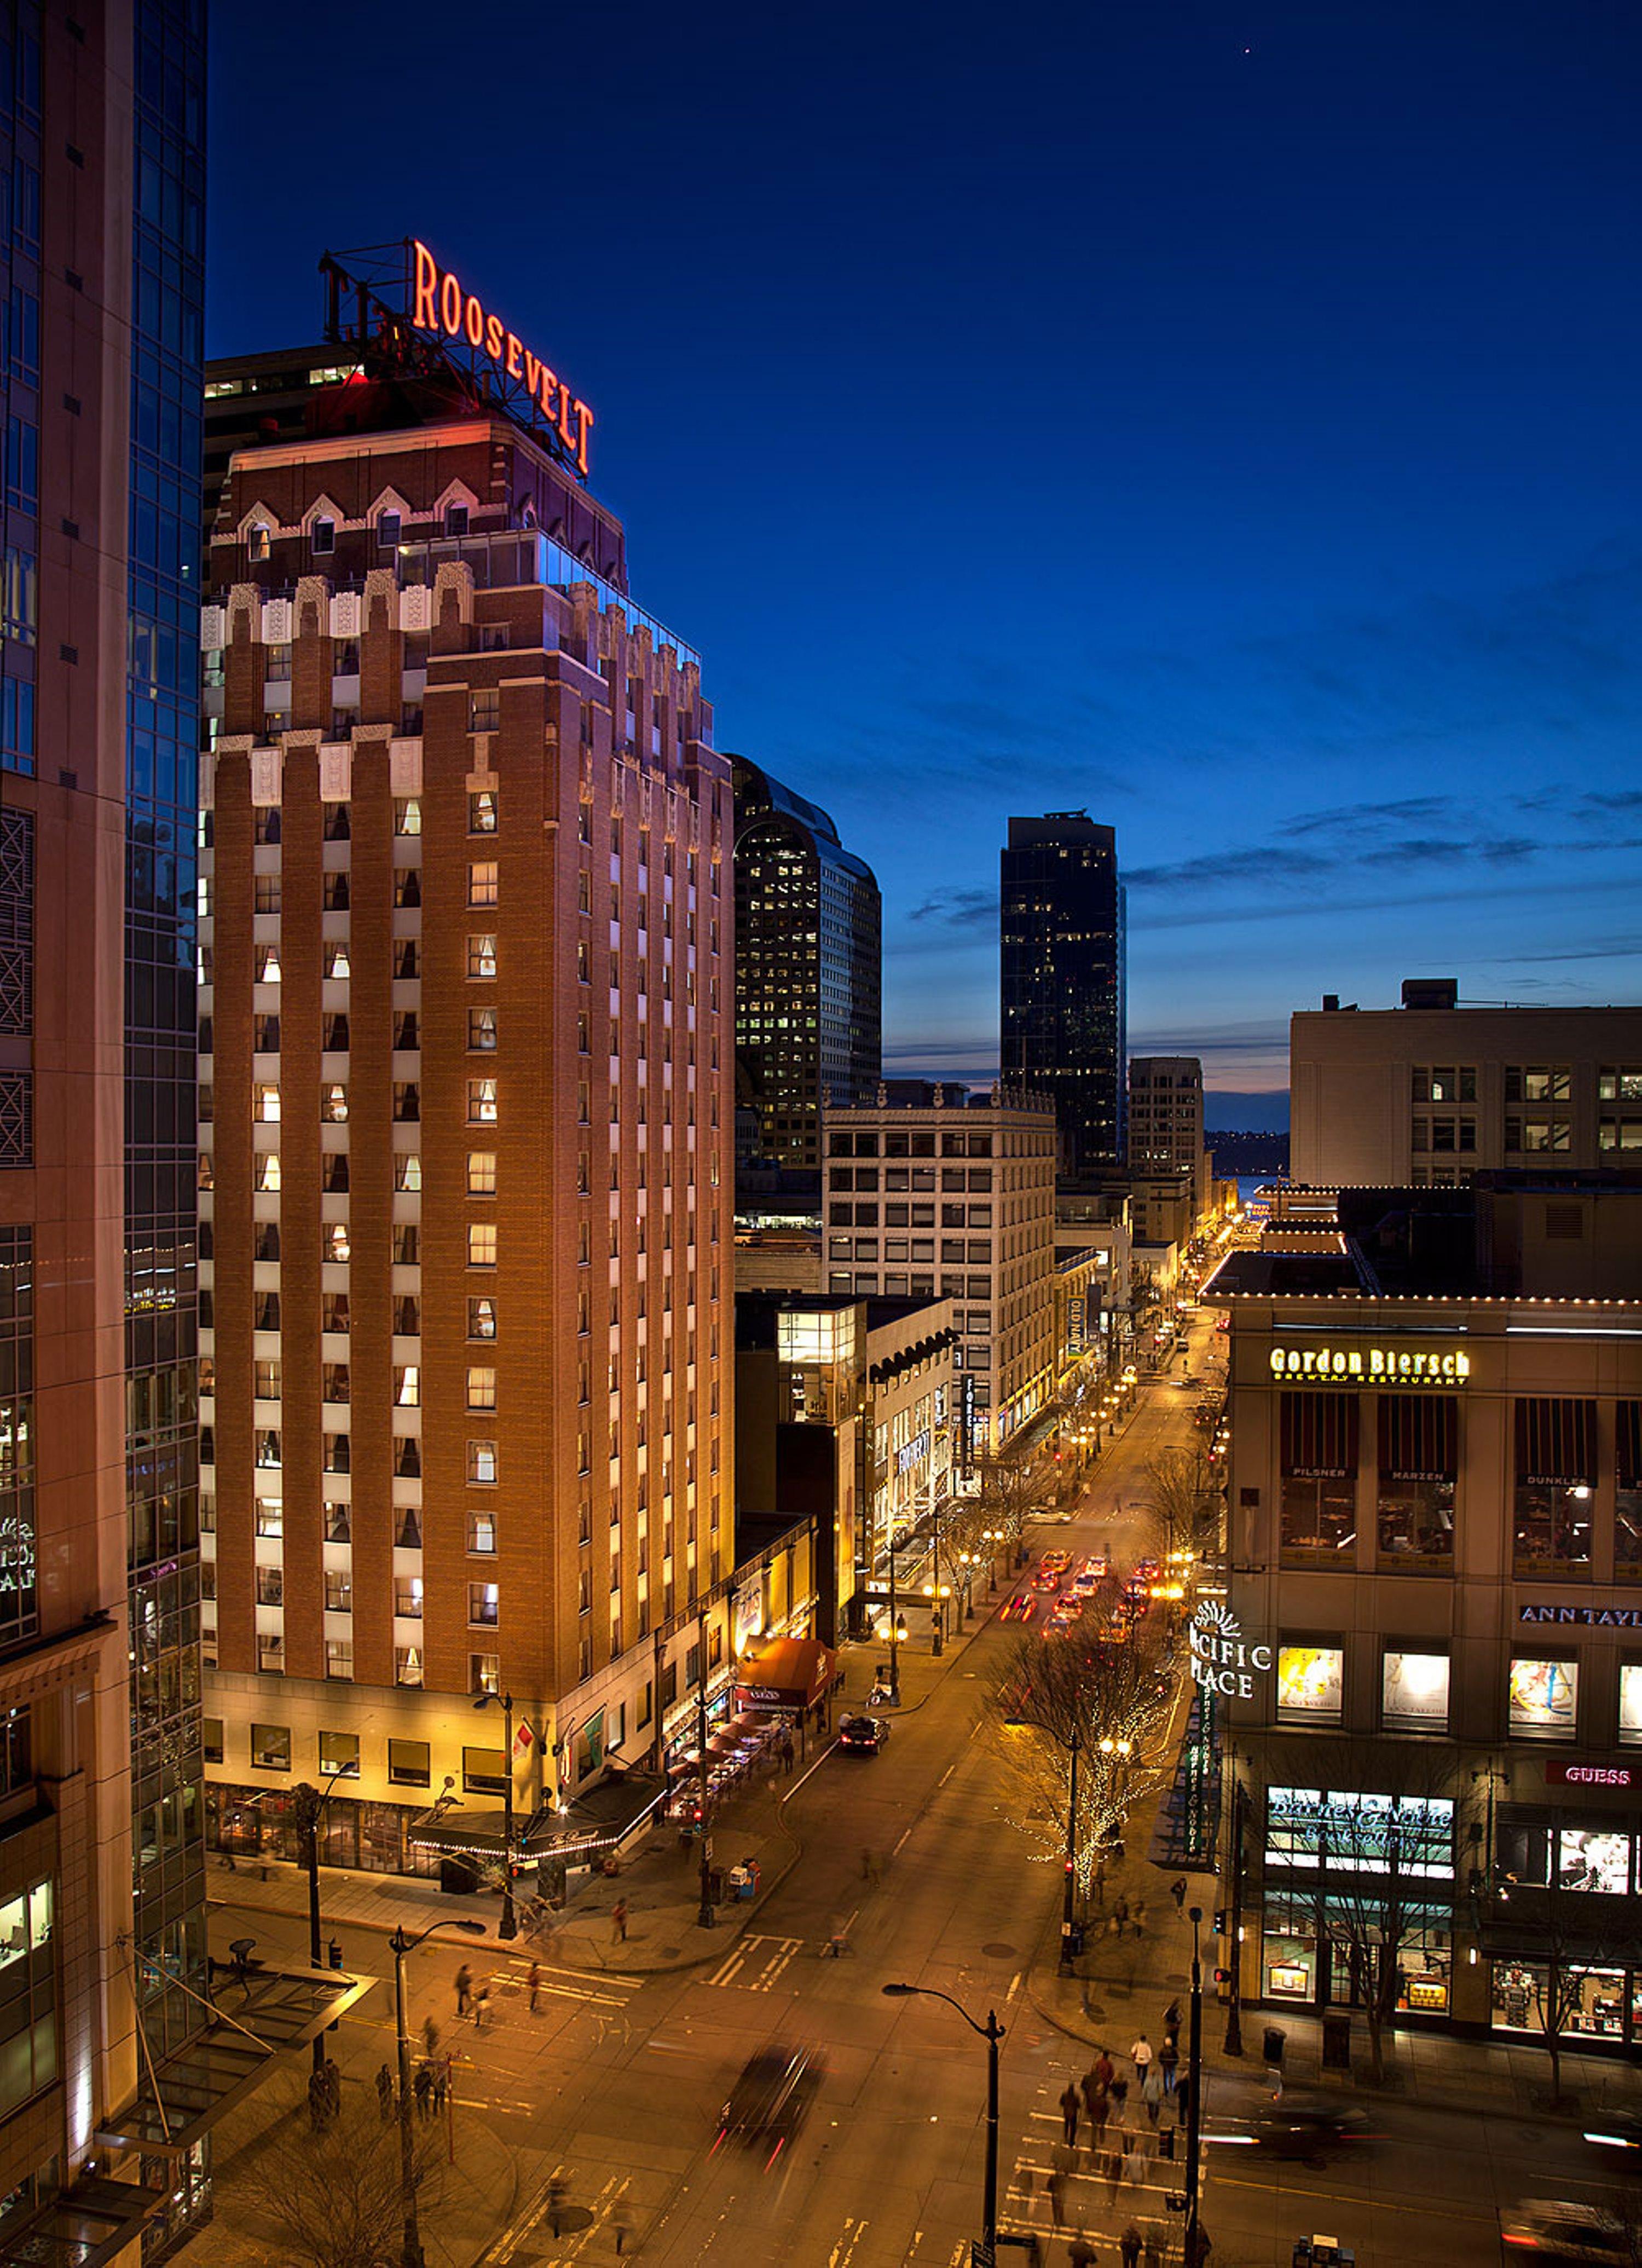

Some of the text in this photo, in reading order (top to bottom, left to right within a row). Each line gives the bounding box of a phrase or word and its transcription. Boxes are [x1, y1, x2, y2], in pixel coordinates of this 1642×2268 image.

[413, 239, 594, 474] ROOSEVELT
[1071, 1300, 1081, 1353] OLD NAVY
[1270, 1348, 1470, 1377] Gordon Biersch
[1274, 1373, 1467, 1384] BREWERY RESTAURANT
[1293, 1467, 1345, 1477] PILSNER
[1527, 1477, 1587, 1485] DUNKLES
[1521, 1606, 1576, 1624] ANN
[1565, 1766, 1631, 1785] GUESS
[1271, 1793, 1356, 1819] Barnes
[1384, 1803, 1452, 1827] Noble
[1304, 1825, 1418, 1850] Booksellers
